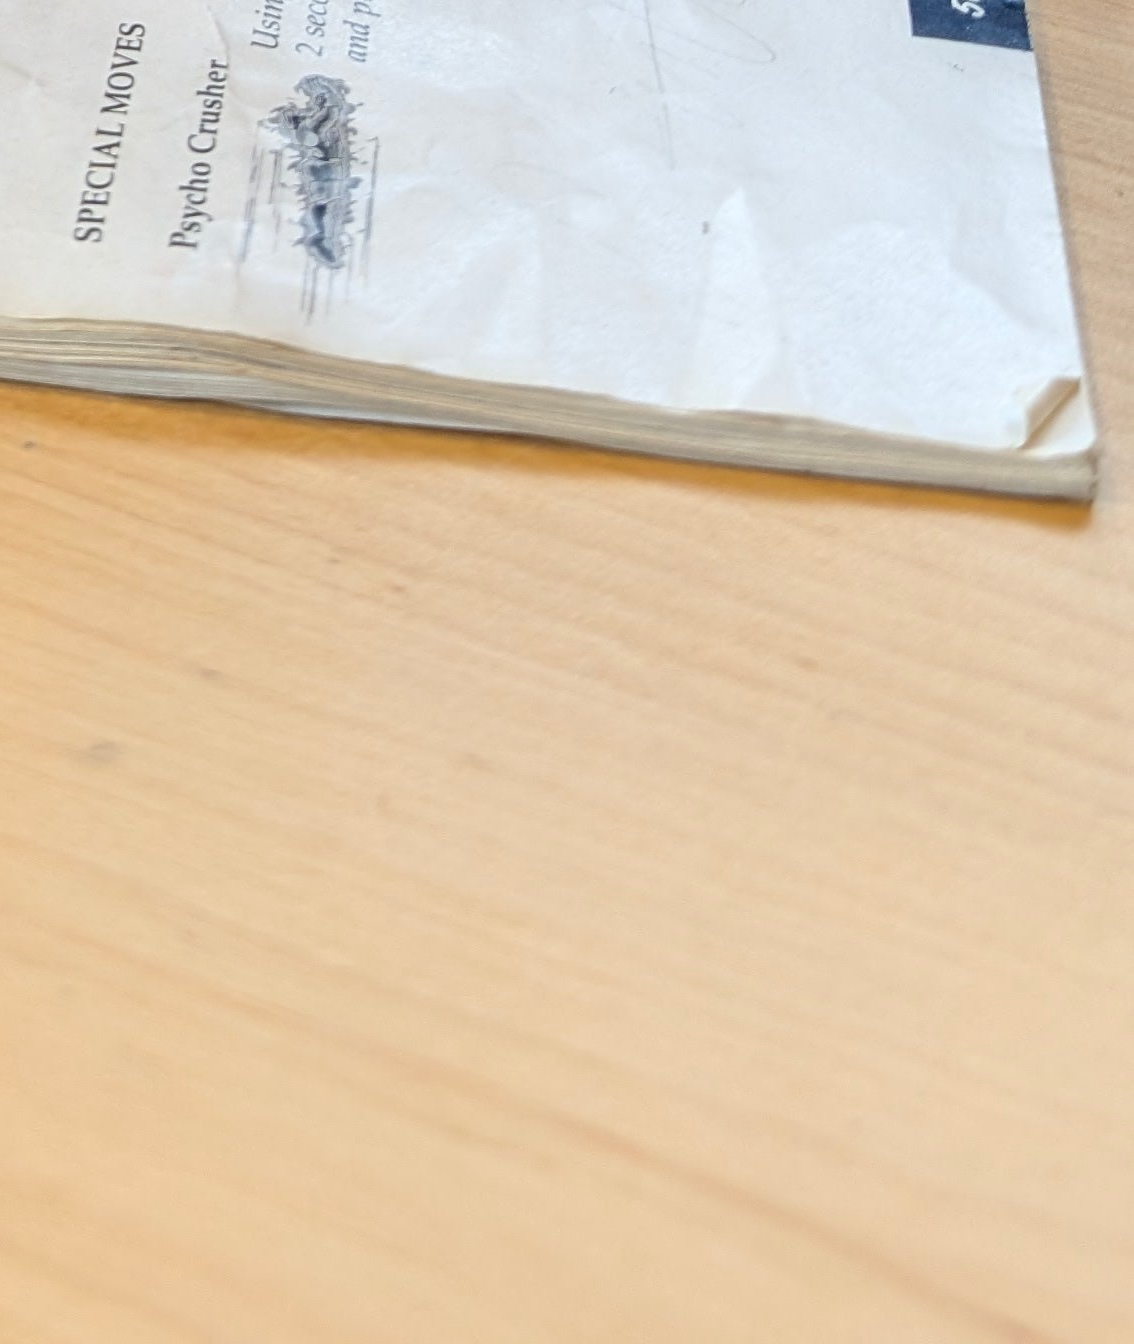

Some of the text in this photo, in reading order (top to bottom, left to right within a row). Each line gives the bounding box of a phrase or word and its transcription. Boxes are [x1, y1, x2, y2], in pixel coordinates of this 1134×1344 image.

[74, 23, 145, 242] SPECIAL MOVES
[344, 20, 370, 64] and
[169, 59, 230, 248] Psycho Crusher
